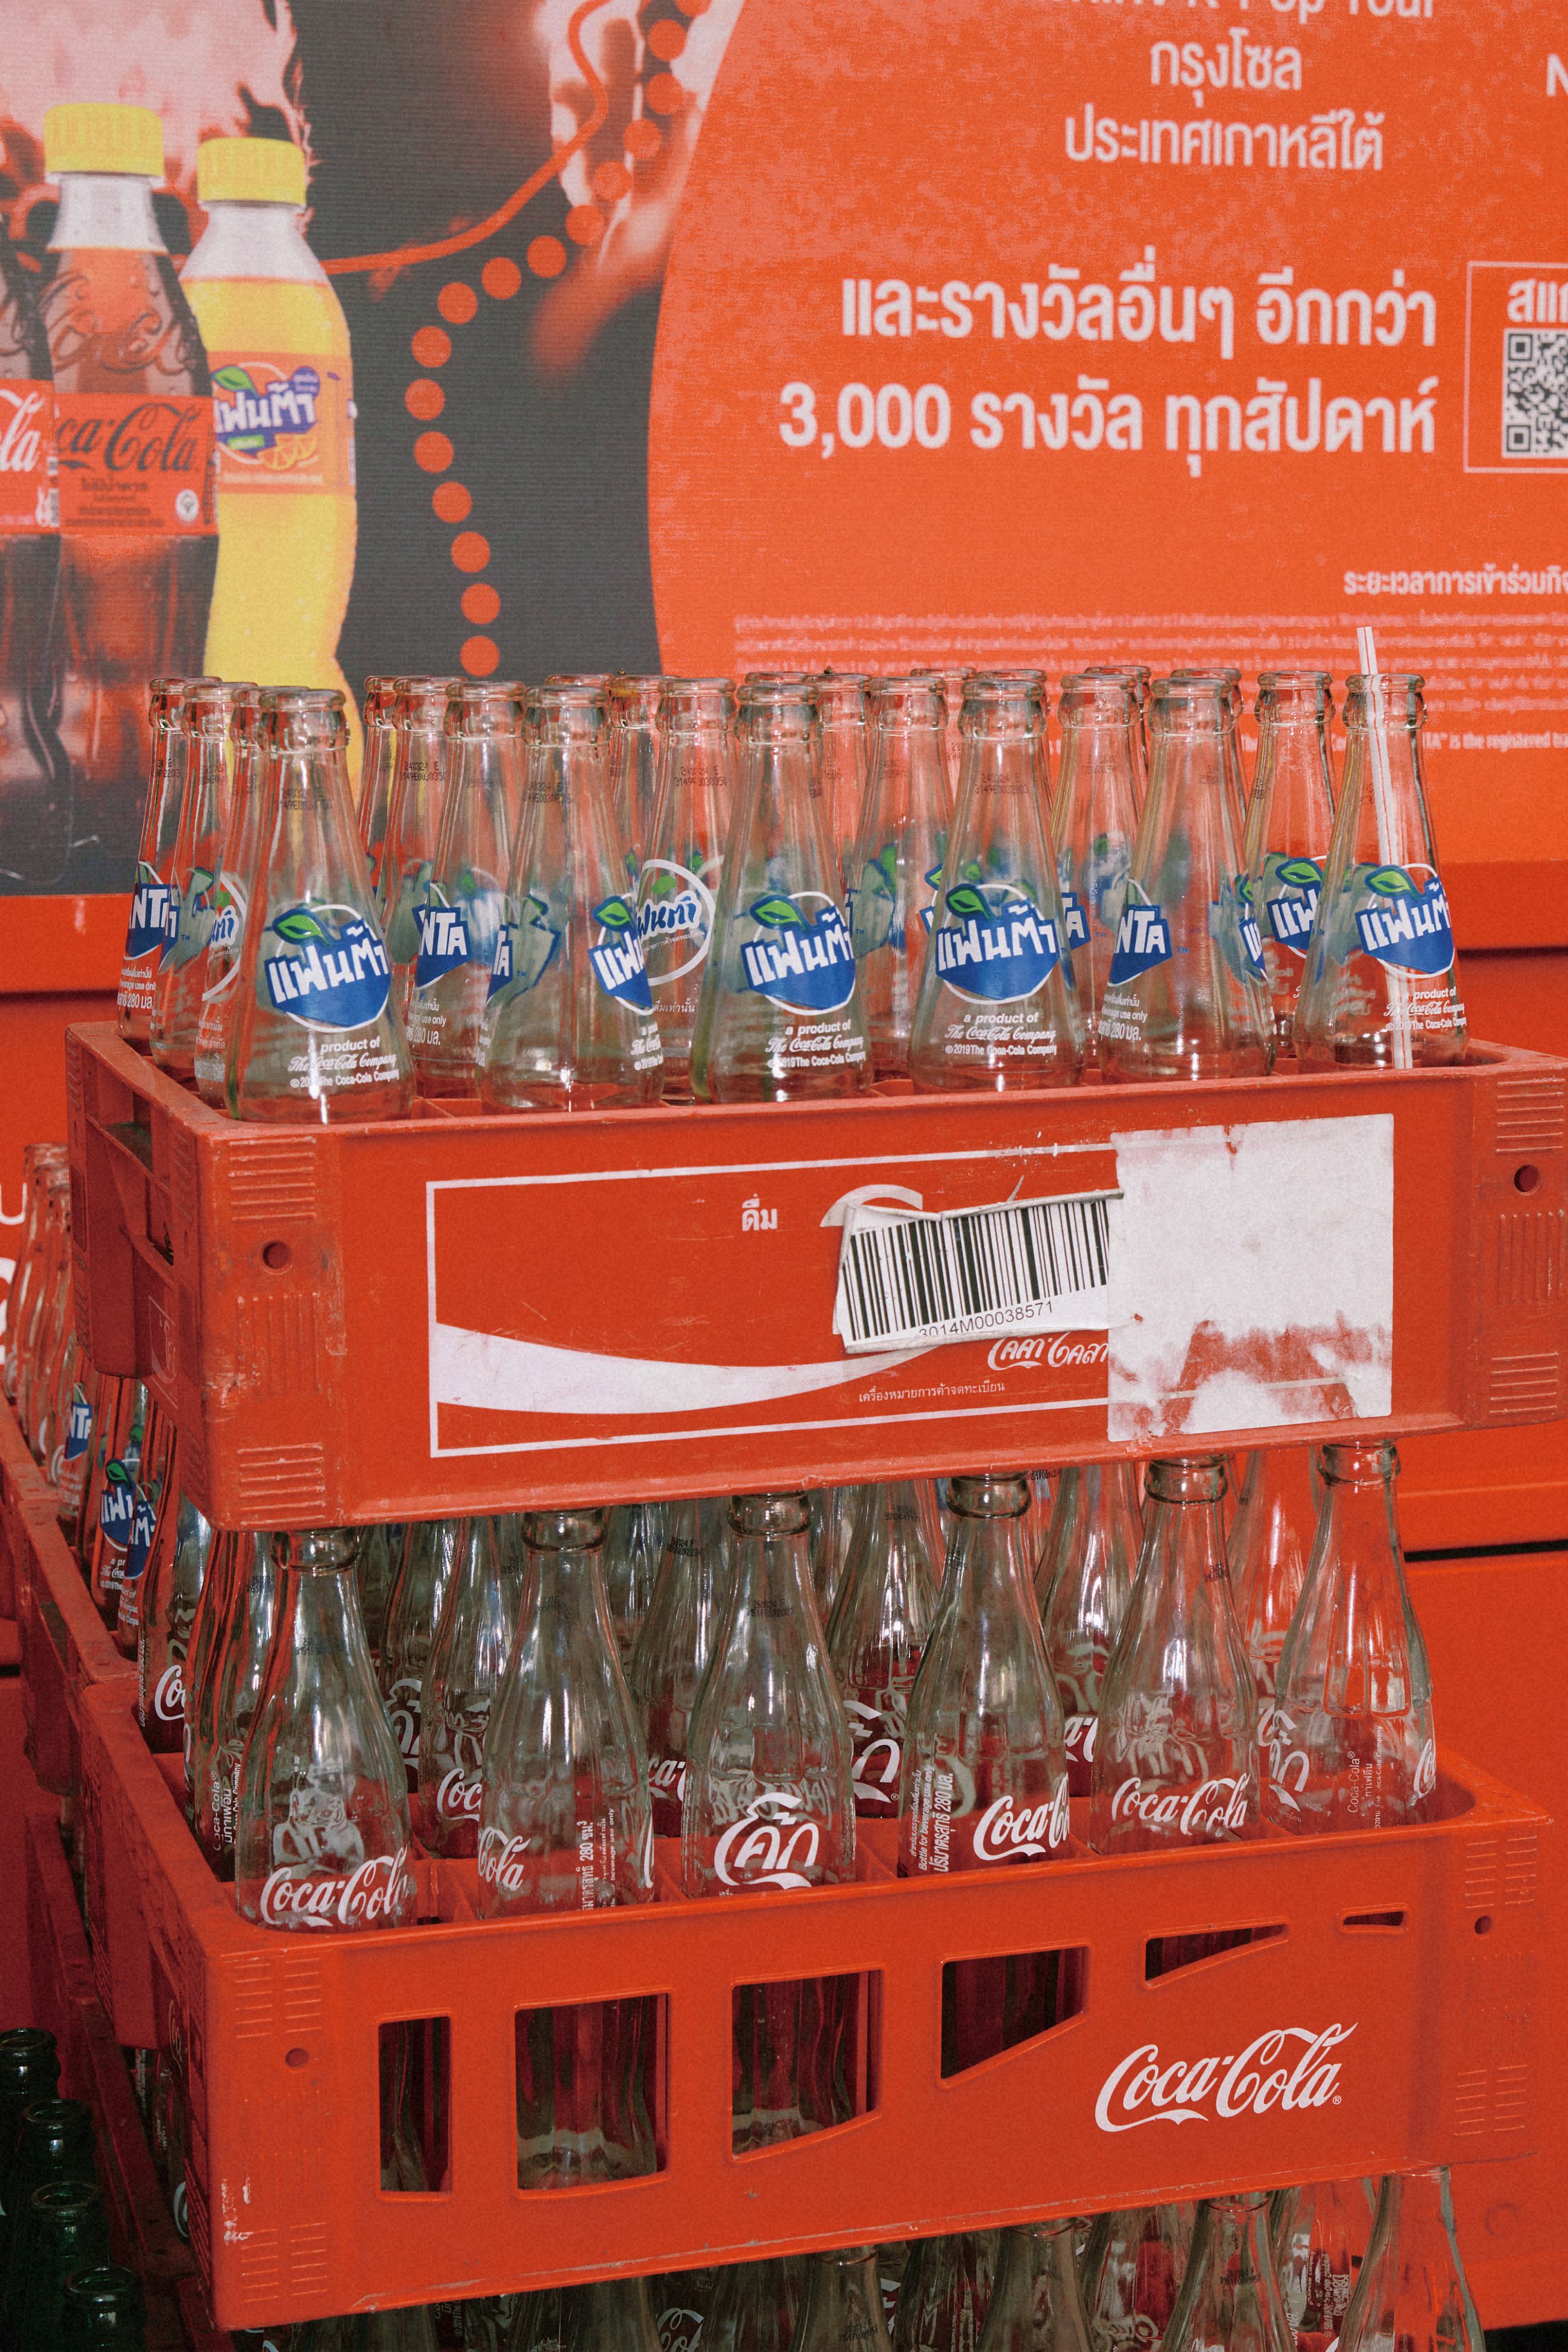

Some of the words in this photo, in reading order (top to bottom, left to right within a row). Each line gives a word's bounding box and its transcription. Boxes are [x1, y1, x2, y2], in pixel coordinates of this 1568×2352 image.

[1150, 27, 1303, 107] กรุงโซล
[1065, 103, 1385, 171] ประเทศเกาหลีใต้
[843, 245, 1234, 360] และรางวัลอื่นๆ
[1256, 266, 1436, 347] อีกกว่า
[779, 381, 951, 459] 3,000
[970, 375, 1143, 450] รางวัล
[1165, 375, 1438, 478] ทุกสัปดาห์
[56, 403, 201, 472] ca-Cola
[938, 906, 1056, 971] แฟนต้า
[746, 912, 854, 986] แฟนต้า
[268, 923, 389, 1004] แฟนต้า
[1413, 987, 1449, 1001] product
[432, 1014, 446, 1028] only
[964, 1014, 971, 1023] a
[975, 1013, 1023, 1025] product
[1026, 1012, 1039, 1023] of
[1132, 1011, 1148, 1023] only
[797, 1022, 841, 1036] product
[842, 1019, 852, 1030] of
[1110, 1023, 1125, 1039] 280
[320, 1038, 367, 1055] product
[370, 1036, 381, 1048] of
[987, 1045, 1025, 1056] Coca-Cola
[1027, 1044, 1057, 1057] Company
[359, 1052, 397, 1070] Company
[811, 1054, 844, 1066] Coca-Cola
[335, 1070, 372, 1086] Coca-Cola
[741, 1193, 778, 1231] ดื่ม
[859, 1379, 1005, 1403] เครื่องหมายการค้าจดทะเบียน
[925, 1765, 935, 1782] only
[936, 1772, 953, 1791] มล.
[934, 1791, 952, 1812] 280
[1112, 1773, 1251, 1836] Coca-Cola
[920, 1800, 932, 1834] beverage
[918, 1834, 928, 1847] for
[929, 1812, 956, 1872] ปริมาตรสุทธิ
[579, 1842, 594, 1862] 280
[918, 1848, 928, 1871] Bottle
